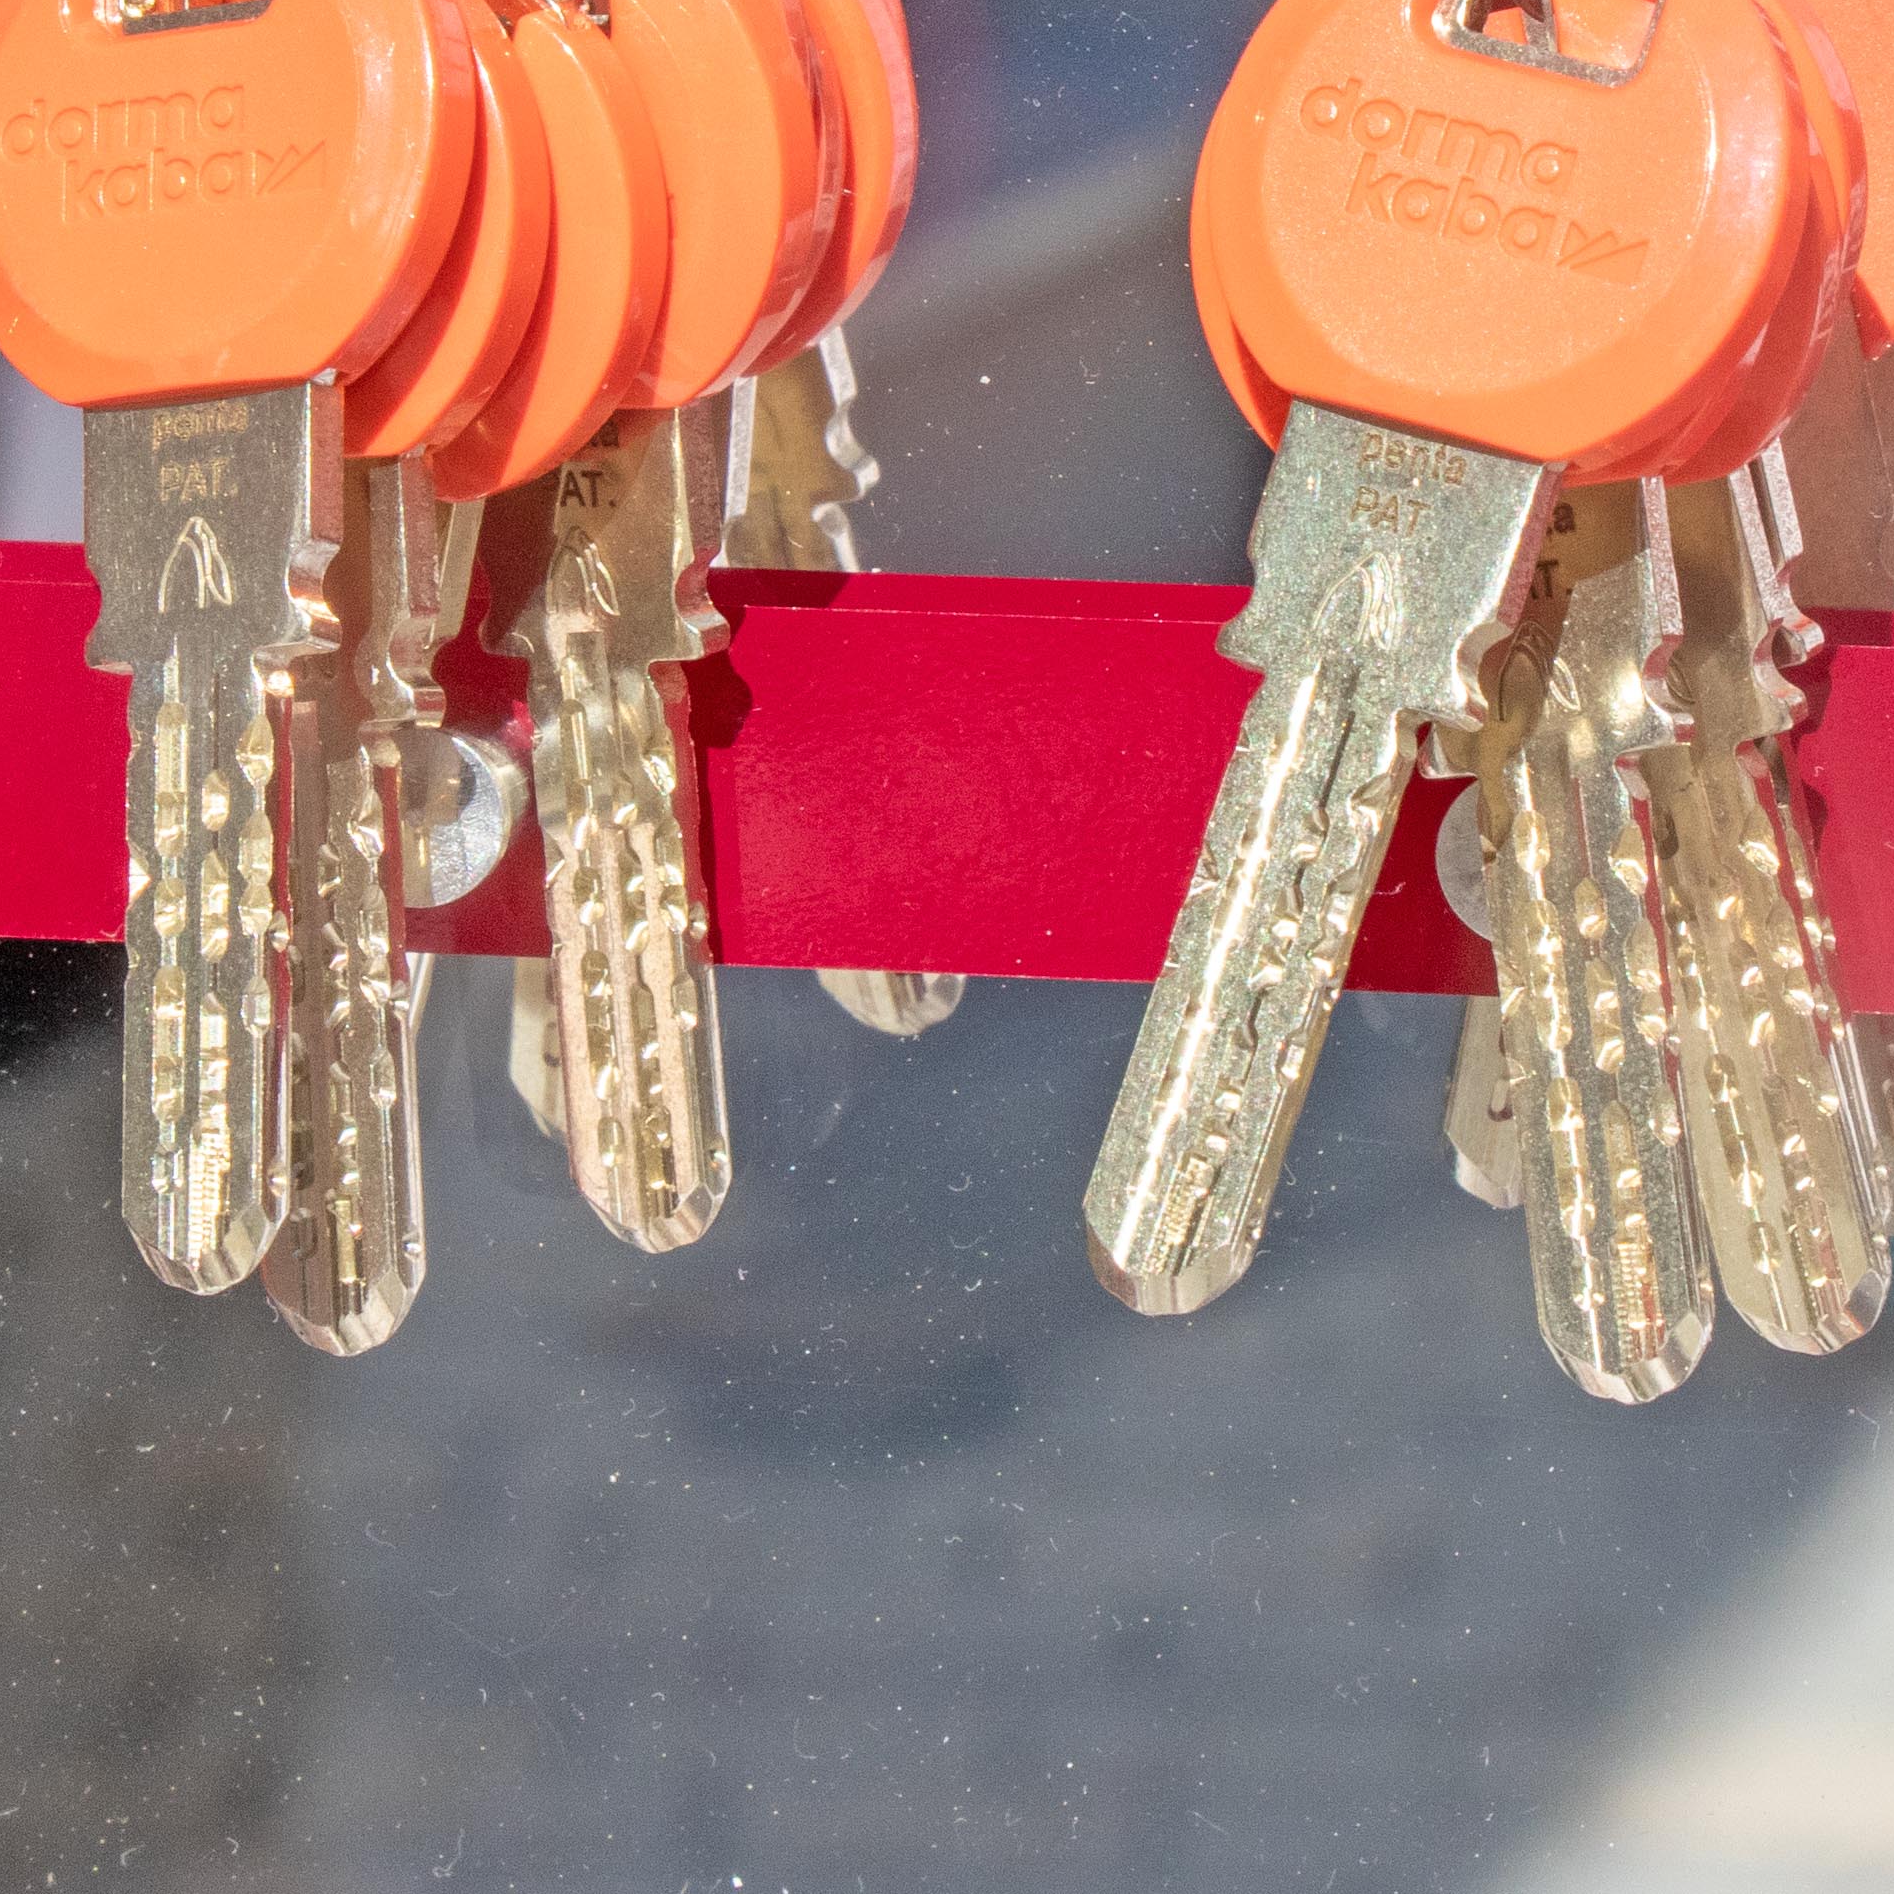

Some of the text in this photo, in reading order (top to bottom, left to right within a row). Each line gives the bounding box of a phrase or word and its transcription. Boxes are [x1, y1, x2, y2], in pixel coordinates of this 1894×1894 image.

[61, 147, 244, 225] kaba
[1299, 77, 1579, 198] dorma
[1343, 151, 1556, 260] kaba
